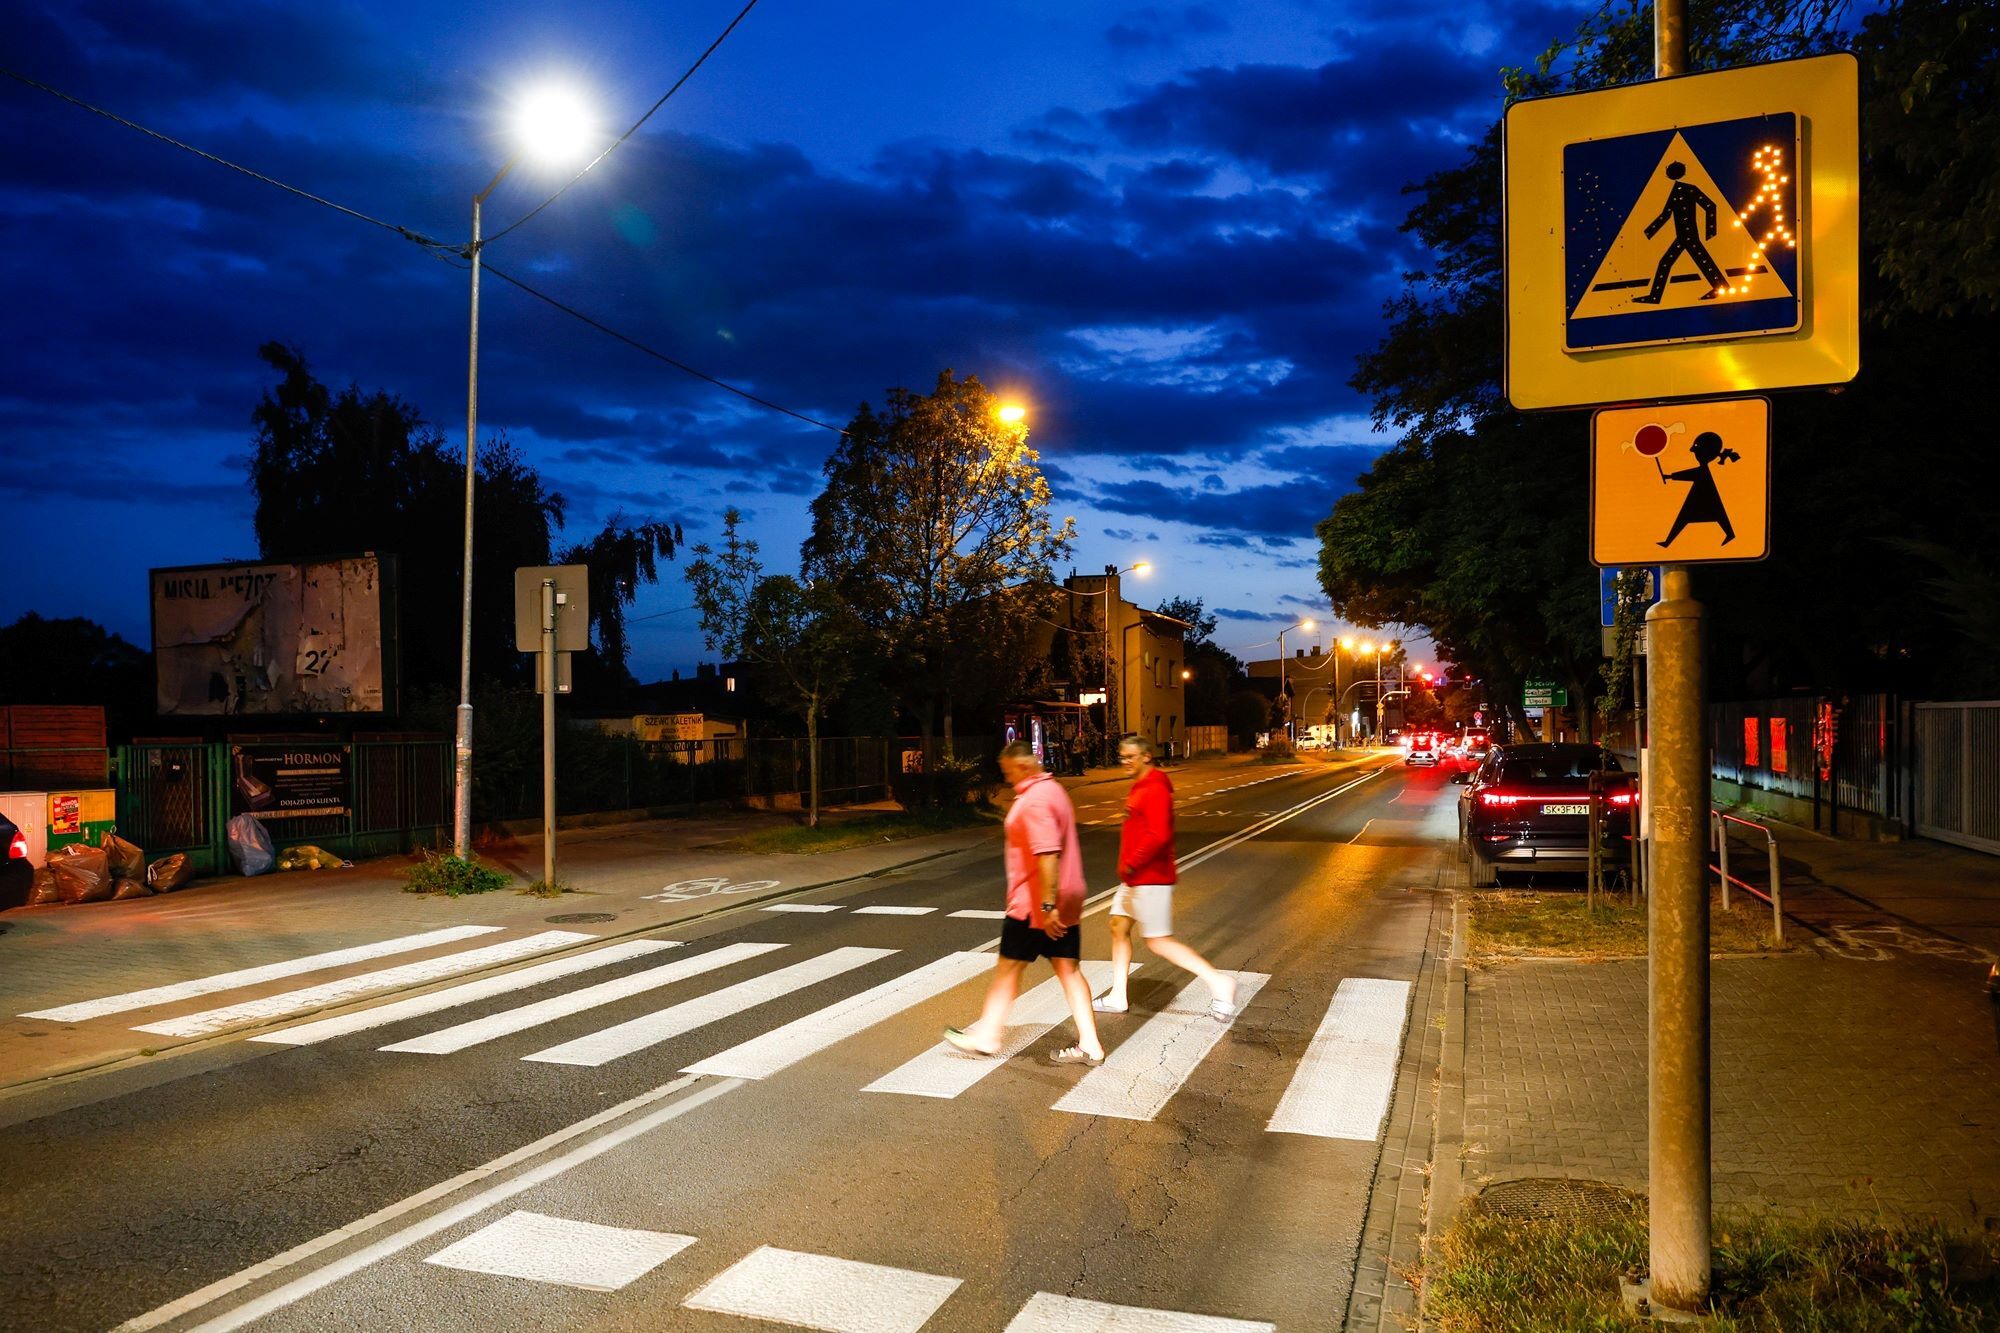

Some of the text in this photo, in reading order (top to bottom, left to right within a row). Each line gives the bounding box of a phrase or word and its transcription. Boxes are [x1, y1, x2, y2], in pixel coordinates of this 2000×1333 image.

[671, 715, 702, 725] KALETNIK
[284, 753, 341, 765] HORMON
[1545, 806, 1588, 814] SK 3F121
